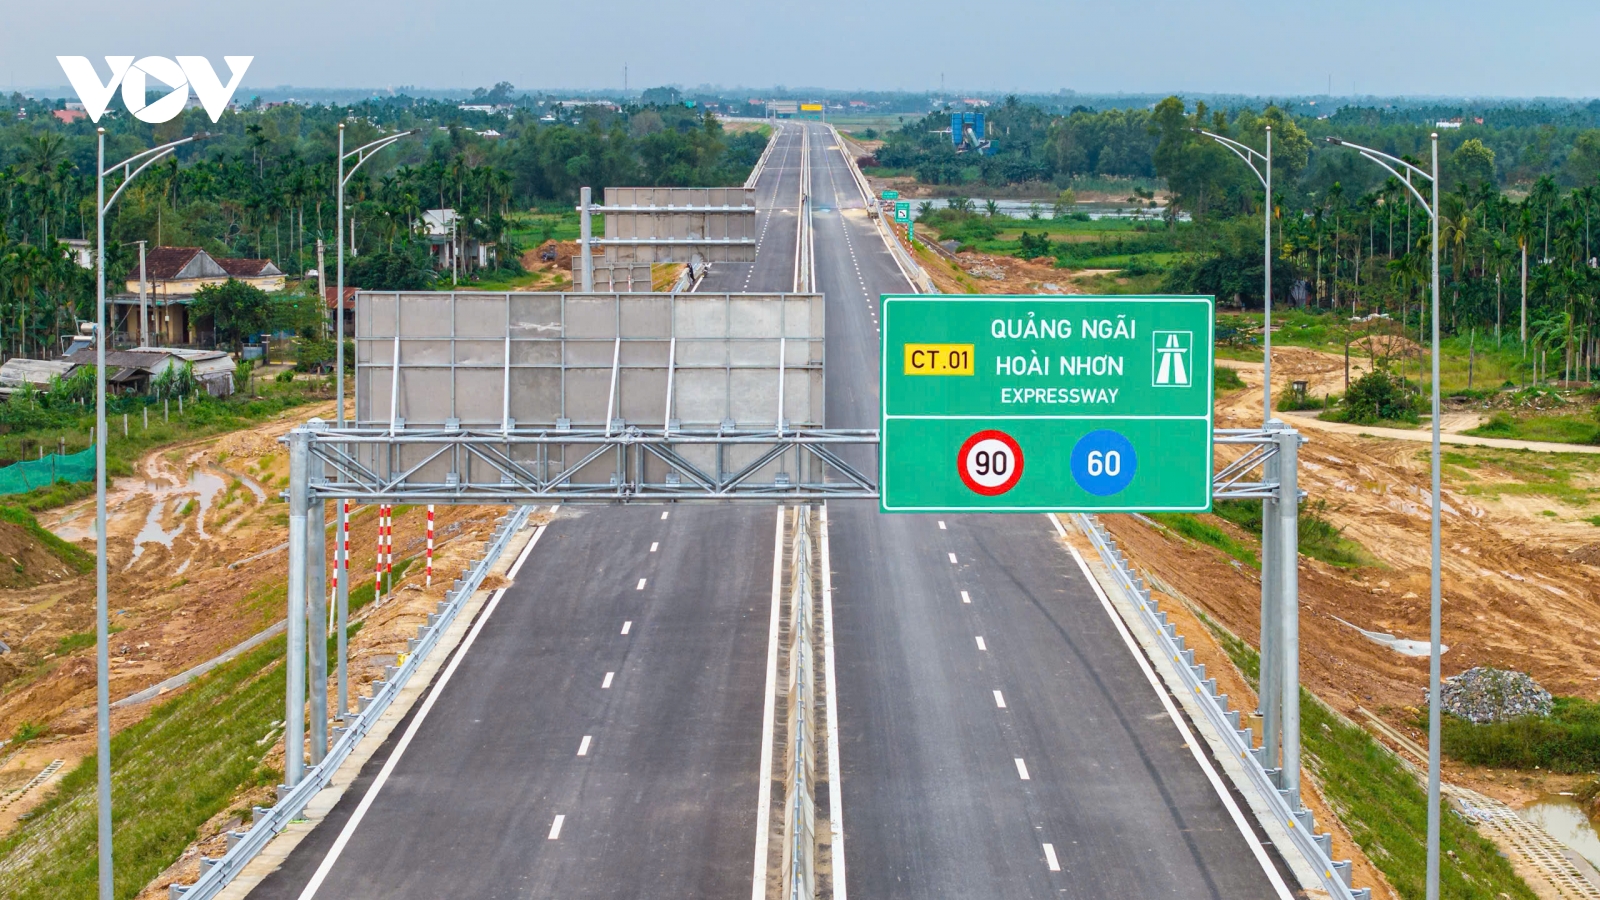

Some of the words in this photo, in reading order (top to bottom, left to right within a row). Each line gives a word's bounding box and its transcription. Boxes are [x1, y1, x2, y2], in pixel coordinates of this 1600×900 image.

[991, 312, 1072, 339] QUẢNG
[1082, 314, 1136, 339] NGÃI
[911, 350, 968, 369] CT.01
[996, 350, 1049, 376] HOÀI
[1060, 354, 1124, 376] NHƠN
[1001, 388, 1119, 404] EXPRESSWAY
[975, 451, 1008, 476] 90
[1087, 451, 1121, 477] 60
